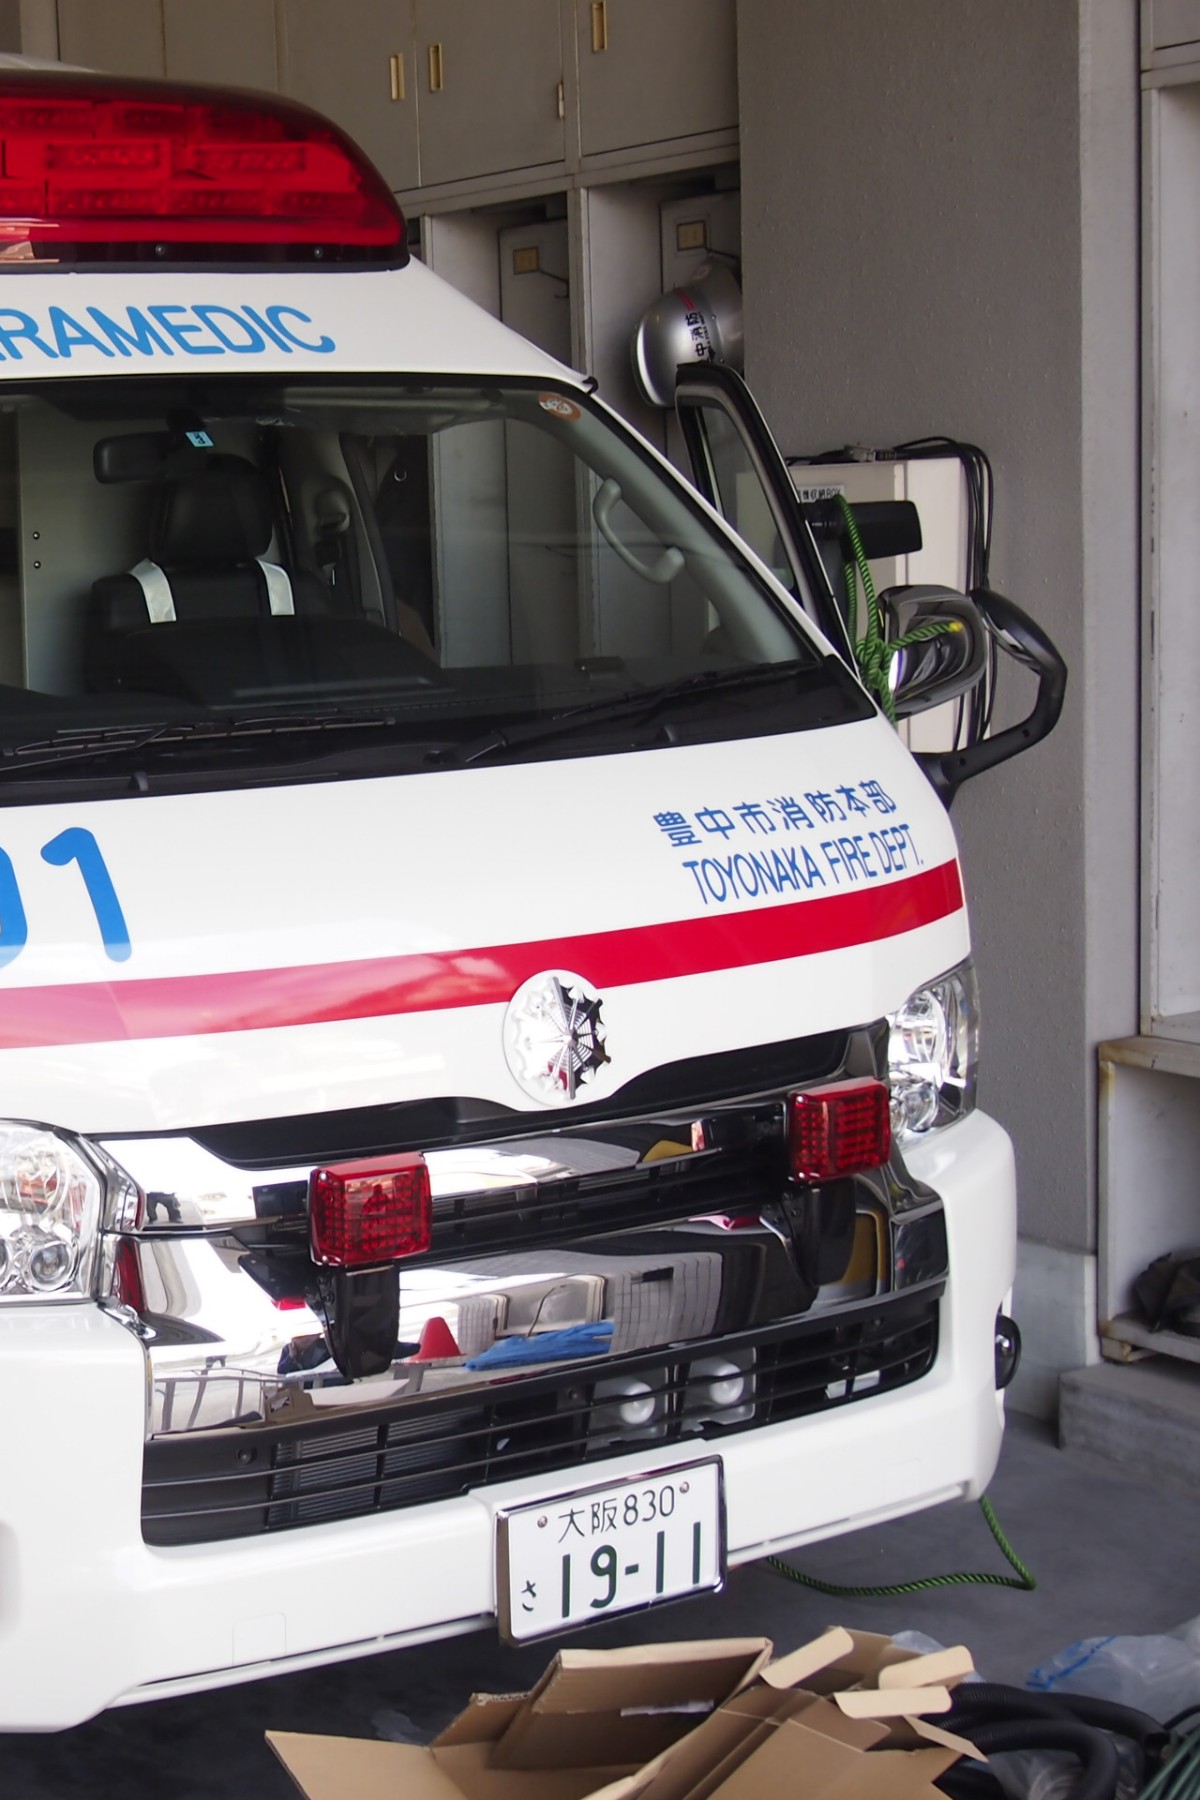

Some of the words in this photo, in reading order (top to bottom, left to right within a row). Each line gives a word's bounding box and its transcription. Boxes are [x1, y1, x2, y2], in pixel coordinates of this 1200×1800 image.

[652, 779, 897, 848] 豊中市消防本部
[681, 844, 826, 904] TOYONAKA
[820, 835, 877, 884] FIRE
[869, 824, 924, 874] DEPT.
[521, 1580, 537, 1612] さ
[561, 1521, 701, 1619] 19-11
